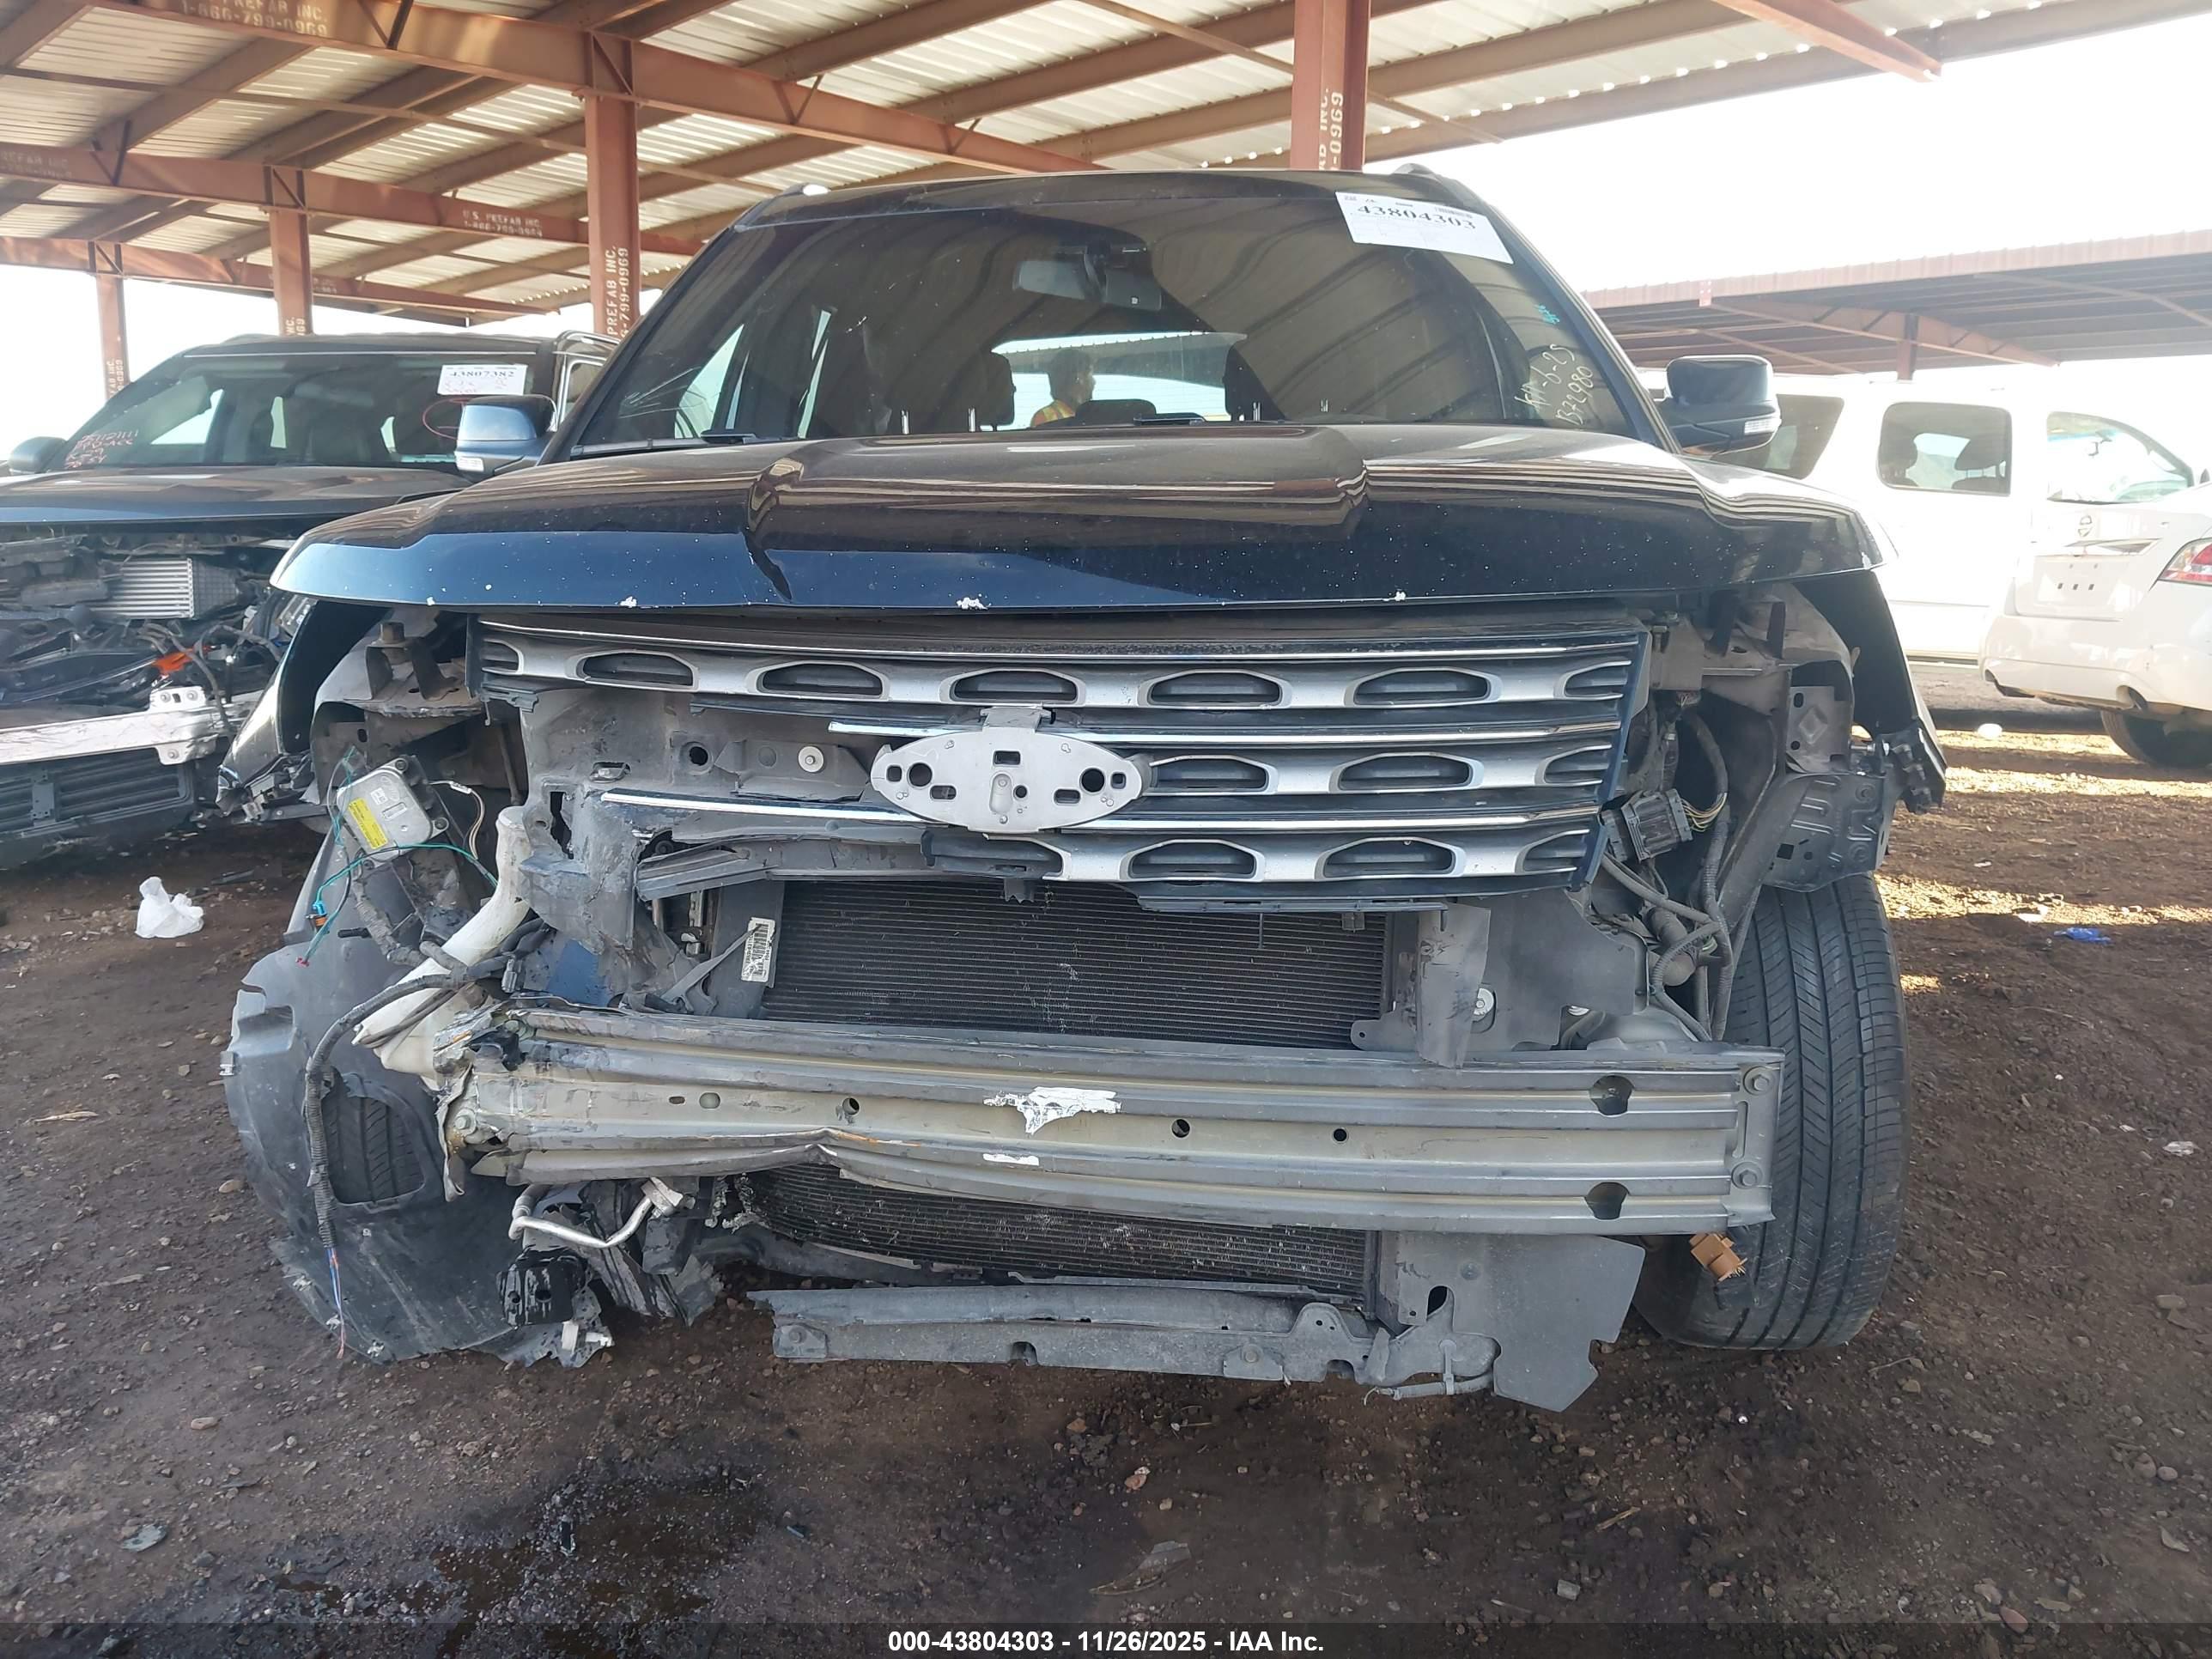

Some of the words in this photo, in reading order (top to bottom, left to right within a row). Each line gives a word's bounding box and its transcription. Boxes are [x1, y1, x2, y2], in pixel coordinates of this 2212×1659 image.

[1329, 91, 1344, 170] -0969
[1358, 204, 1476, 229] 43804303
[605, 246, 617, 273] INC.
[606, 279, 618, 336] PREFAB
